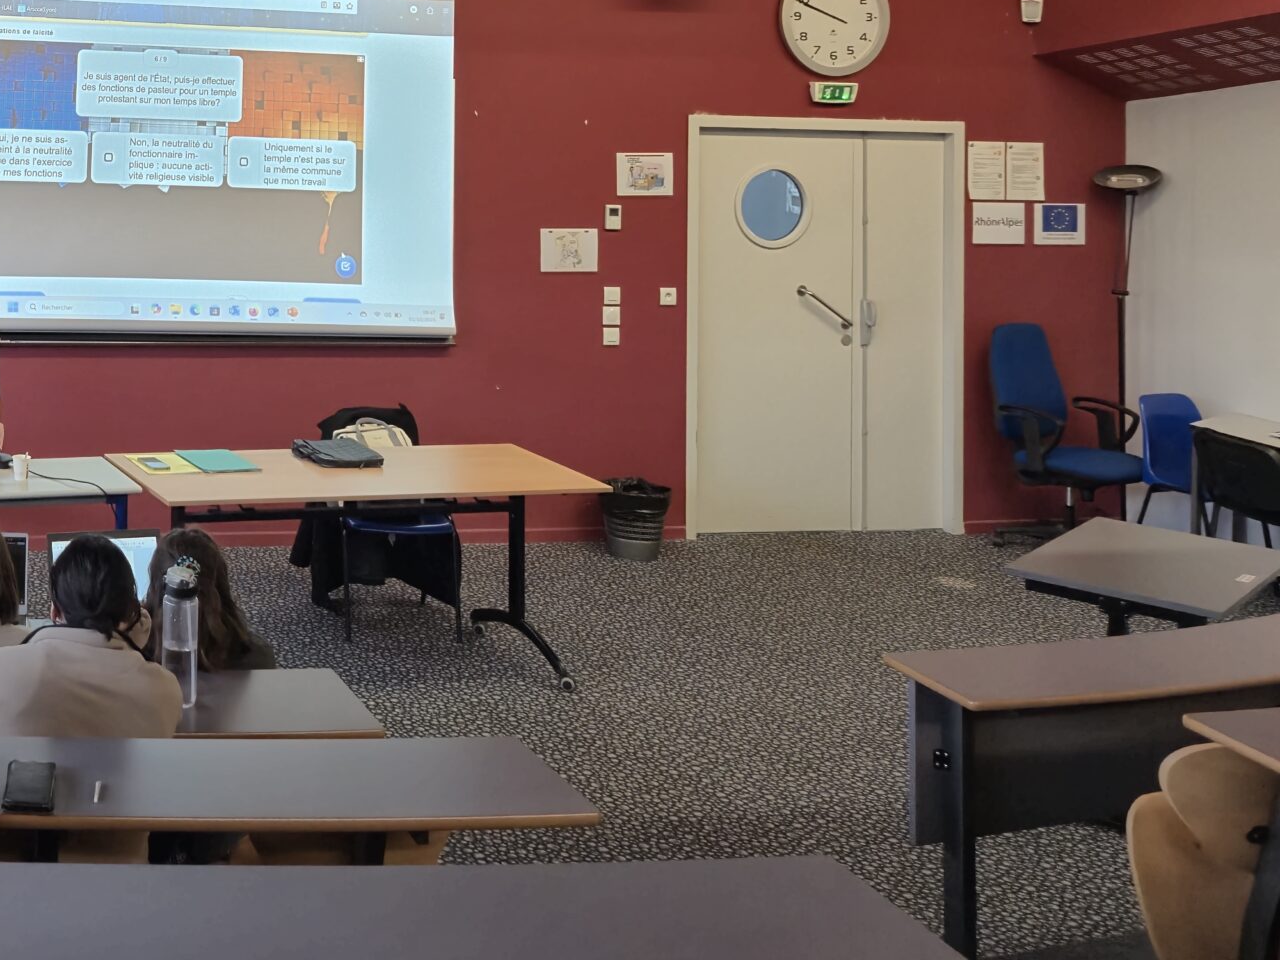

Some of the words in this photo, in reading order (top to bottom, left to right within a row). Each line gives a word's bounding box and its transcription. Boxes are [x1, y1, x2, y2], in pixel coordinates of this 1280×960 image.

[794, 12, 801, 20] 9
[866, 13, 873, 22] 3
[800, 32, 807, 41] 8
[859, 33, 867, 41] 4
[813, 46, 821, 55] 7
[847, 46, 854, 55] 5
[830, 51, 838, 60] 6
[83, 72, 94, 80] Je
[96, 73, 112, 81] suis
[113, 74, 136, 84] agent
[138, 74, 148, 82] de
[174, 77, 200, 86] puis-je
[202, 76, 235, 86] effectuer
[81, 83, 97, 91] des
[98, 83, 133, 93] fonctions
[136, 85, 146, 93] de
[148, 87, 177, 96] pasteur
[179, 88, 197, 97] pour
[211, 89, 237, 99] temple
[98, 94, 138, 104] protestant
[173, 98, 197, 107] temps
[199, 98, 220, 107] libre?
[11, 134, 20, 144] je
[35, 135, 52, 144] suis
[55, 136, 68, 144] as-
[130, 138, 149, 148] Non,
[152, 139, 159, 147] la
[162, 139, 200, 149] neutralité
[203, 140, 213, 149] du
[15, 145, 20, 154] à
[23, 146, 30, 154] la
[33, 146, 72, 155] neutralité
[265, 143, 314, 153] Uniquement
[325, 145, 333, 153] le
[129, 149, 183, 159] fonctionnaire
[185, 151, 198, 159] im-
[9, 157, 30, 165] dans
[32, 158, 72, 166] l'exercice
[264, 155, 292, 164] temple
[294, 155, 314, 163] n'est
[316, 157, 331, 165] pas
[129, 161, 154, 169] plique
[24, 169, 62, 178] fonctions
[264, 165, 271, 173] la
[273, 165, 299, 174] même
[301, 167, 341, 176] commune
[146, 172, 186, 182] religieuse
[189, 173, 214, 182] visible
[264, 178, 279, 186] que
[302, 178, 326, 186] travail
